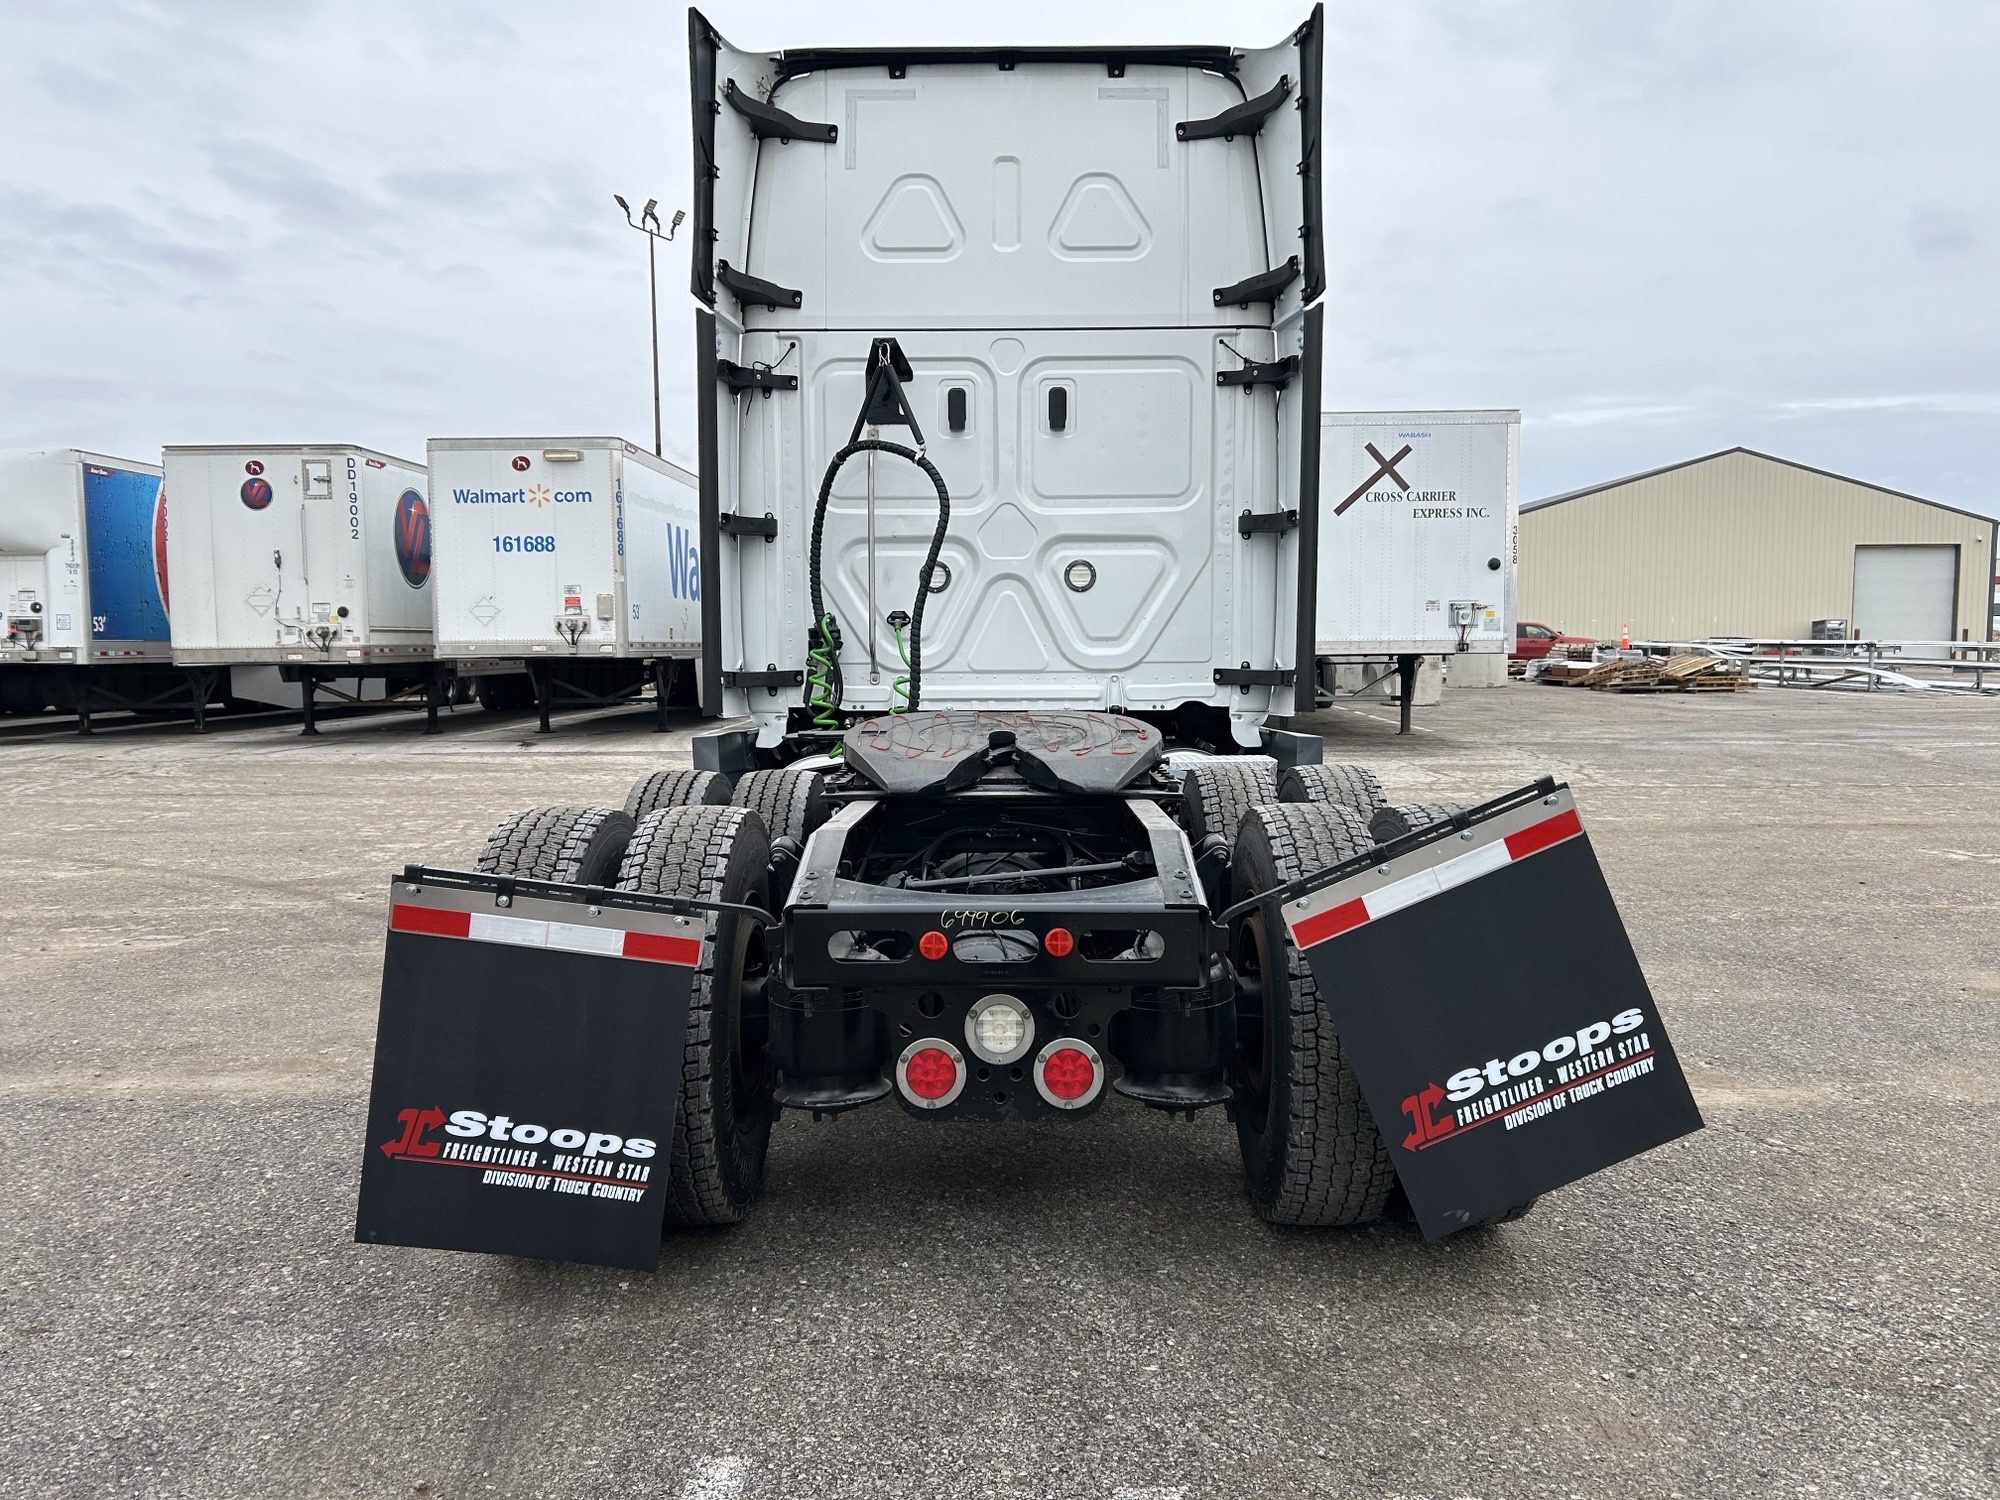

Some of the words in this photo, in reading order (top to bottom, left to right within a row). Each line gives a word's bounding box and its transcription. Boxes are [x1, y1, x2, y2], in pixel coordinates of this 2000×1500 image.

[346, 457, 359, 540] DD19002
[452, 488, 526, 505] Walmart
[554, 488, 592, 504] com
[615, 477, 625, 557] 161688
[1365, 490, 1403, 503] CROSS
[1406, 490, 1457, 503] CARRIER
[1412, 507, 1463, 519] EXPRESS
[1466, 507, 1490, 519] INC.
[492, 535, 556, 553] 161688
[1511, 525, 1519, 565] 3058
[1445, 1007, 1645, 1102] Stoops
[1456, 1075, 1545, 1127] FREIGHTLINER
[1556, 1053, 1615, 1085] WESTERN
[1618, 1032, 1651, 1060] STAR
[1503, 1099, 1553, 1131] DIVISION
[1552, 1093, 1568, 1110] OF
[1569, 1079, 1605, 1104] TRUCK
[1605, 1056, 1656, 1090] COUNTRY
[444, 1110, 657, 1158] Stoops
[442, 1141, 537, 1168] FREIGHTLINER
[552, 1154, 614, 1178] WESTERN
[616, 1163, 651, 1183] STAR
[482, 1169, 535, 1190] DIVISION
[535, 1176, 551, 1191] OF
[552, 1177, 591, 1197] TRUCK
[591, 1182, 646, 1203] COUNTRY
